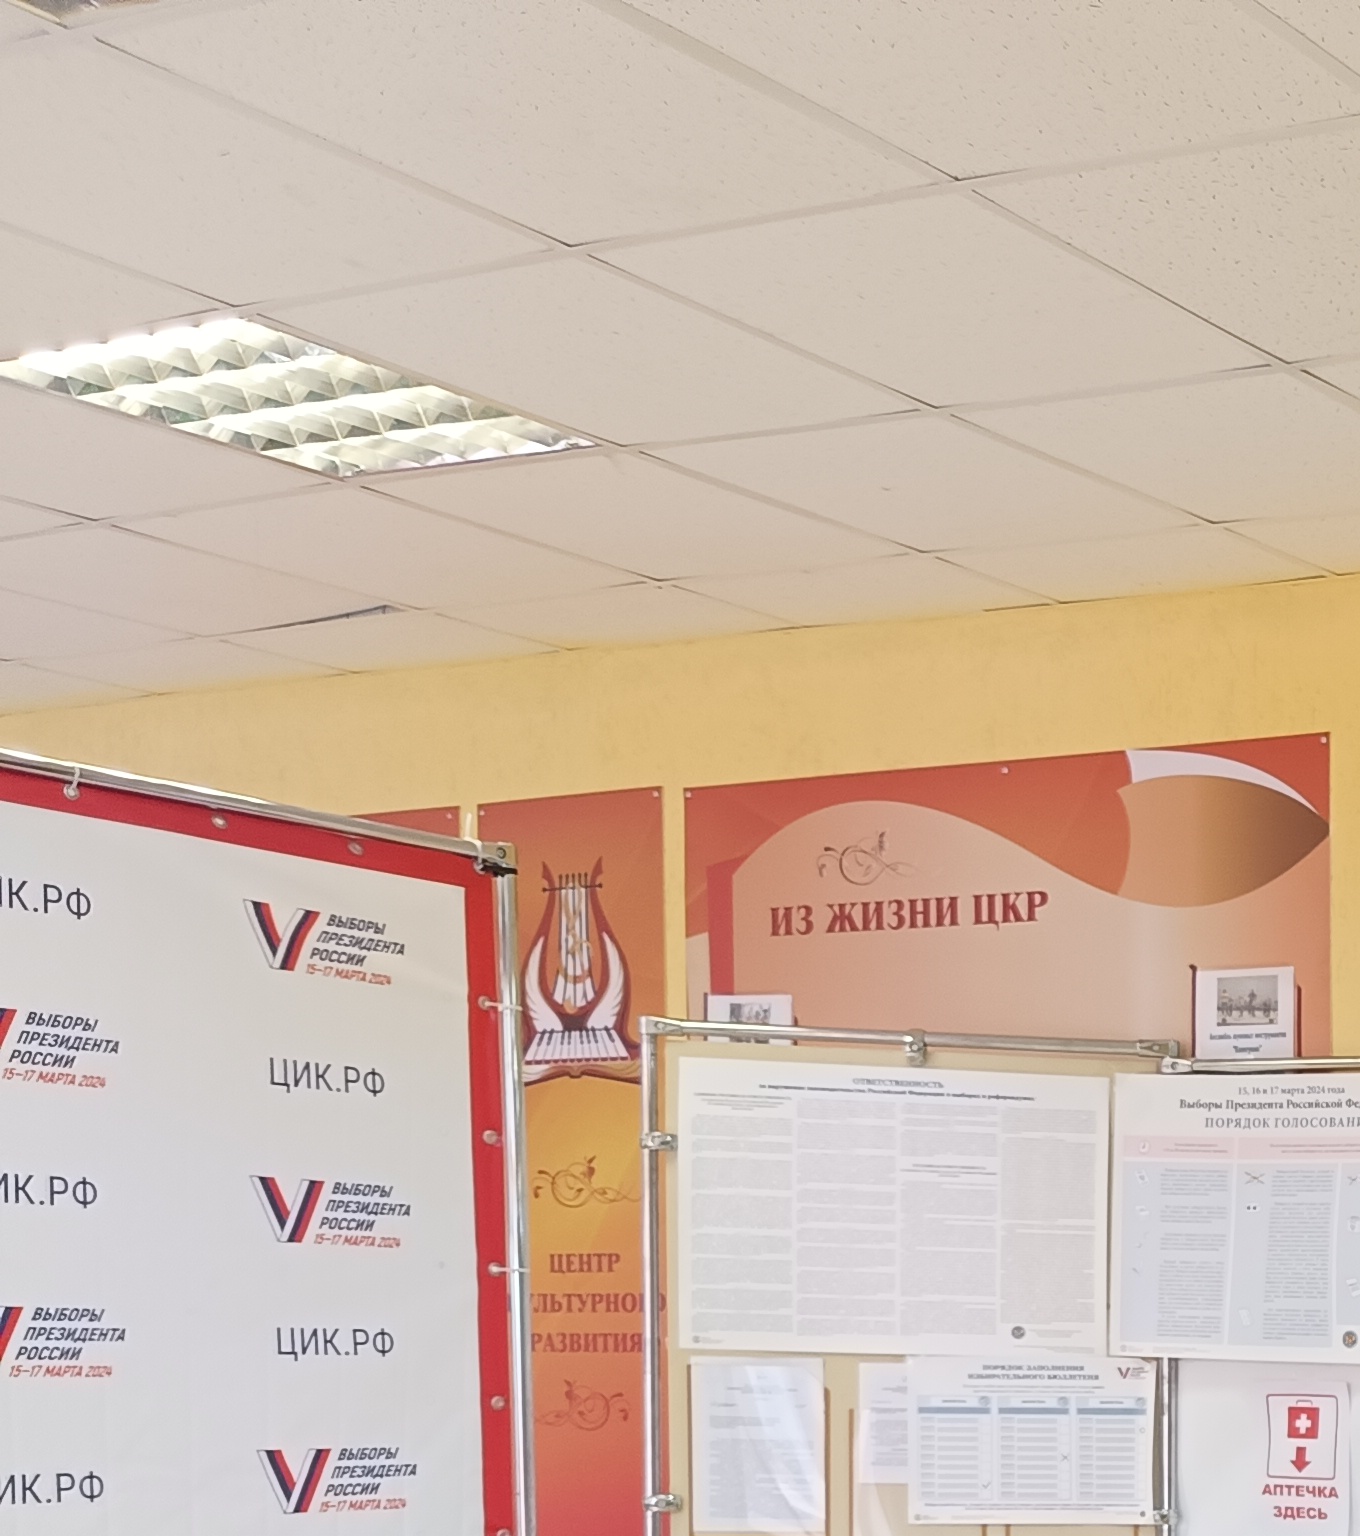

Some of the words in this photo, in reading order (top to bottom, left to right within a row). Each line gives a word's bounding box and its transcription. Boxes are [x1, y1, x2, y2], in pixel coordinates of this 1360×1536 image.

[769, 903, 814, 937] ИЗ
[825, 895, 961, 934] ЖИЗНИ
[971, 889, 1049, 932] ЦКР
[326, 913, 386, 935] ВЫБОРЫ
[315, 930, 405, 955] ПРЕЗИДЕНТА
[309, 947, 367, 967] РОССИИ
[24, 1011, 98, 1032] ВЫБОРЫ
[16, 1030, 119, 1054] ПРЕЗИДЕНТА
[8, 1048, 76, 1068] РОССИИ
[268, 1057, 386, 1097] ЦИК.РФ
[1252, 1087, 1261, 1096] 16
[1270, 1087, 1279, 1096] 17
[1280, 1088, 1305, 1099] марта
[1306, 1086, 1326, 1095] 2024
[1328, 1087, 1346, 1096] года
[1179, 1098, 1223, 1111] Выборы
[1225, 1099, 1284, 1112] Президента
[1286, 1097, 1343, 1111] Российской
[1205, 1116, 1271, 1130] ПОРЯДОК
[331, 1181, 393, 1197] ВЫБОРЫ
[324, 1199, 410, 1216] ПРЕЗИДЕНТА
[318, 1216, 375, 1231] РОССИИ
[549, 1253, 621, 1274] ЦЕНТР
[30, 1306, 104, 1322] ВЫБОРЫ
[22, 1326, 126, 1343] ПРЕЗИДЕНТА
[531, 1332, 643, 1353] РАЗВИТИЯ
[14, 1345, 82, 1360] РОССИИ
[276, 1326, 394, 1362] ЦИК.РФ
[337, 1446, 399, 1461] ВЫБОРЫ
[330, 1463, 417, 1479] ПРЕЗИДЕНТА
[0, 1471, 104, 1505] ИК.РФ
[323, 1482, 381, 1496] РОССИИ
[1262, 1484, 1339, 1498] АПТЕЧКА
[1273, 1506, 1328, 1520] ЗДЕСЬ
